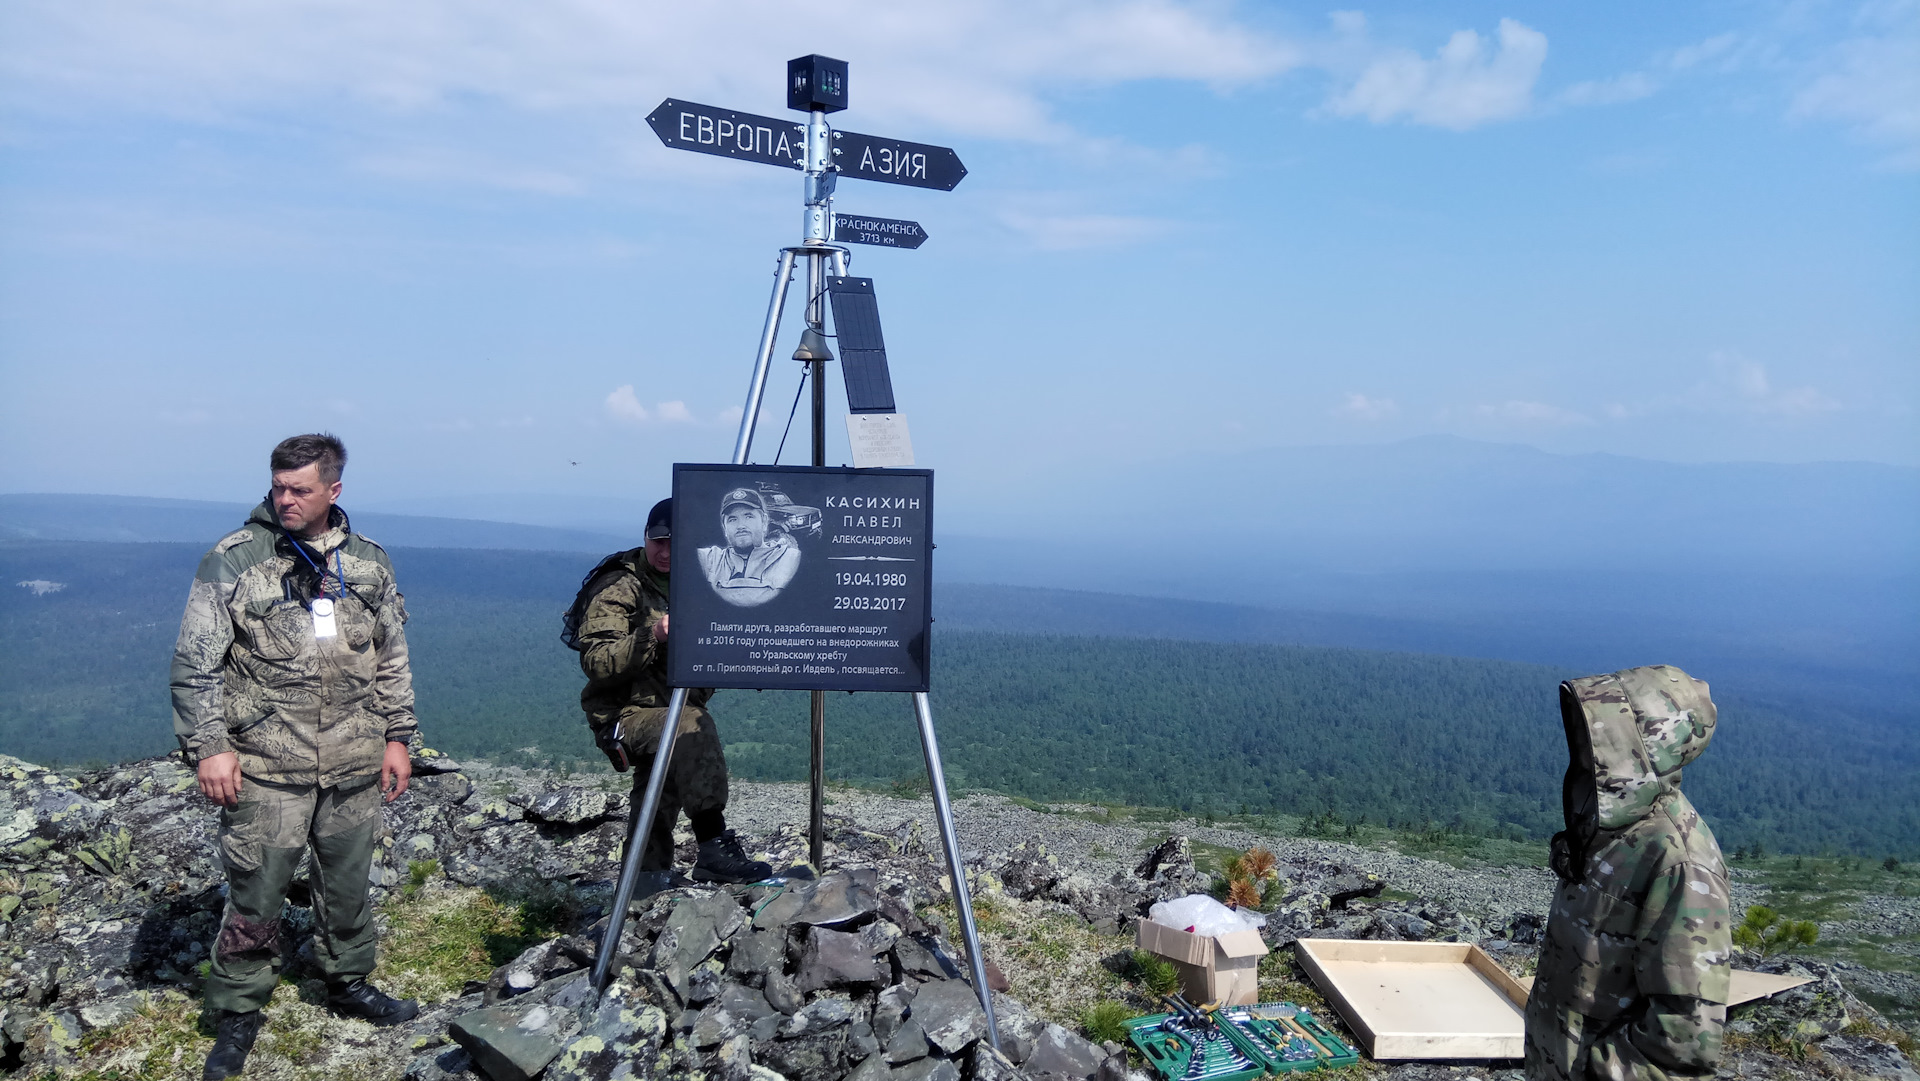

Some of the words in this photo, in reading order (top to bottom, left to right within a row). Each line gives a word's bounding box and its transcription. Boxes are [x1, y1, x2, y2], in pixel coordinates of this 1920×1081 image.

[680, 112, 792, 158] ЕВРОПА
[860, 146, 926, 179] АЗИЯ
[835, 218, 919, 236] КРАСНОКАМЕНСК
[859, 232, 880, 243] 3713
[883, 237, 895, 245] км
[826, 496, 920, 509] КАСИХИН
[843, 516, 902, 527] ПАВЕЛ
[832, 535, 912, 545] АЛЕКСАНДРОВИЧ
[836, 572, 907, 586] 19.04.1980
[833, 597, 906, 610] 29.03.2017
[710, 622, 743, 632] Памяти
[745, 624, 772, 633] друга,
[774, 623, 846, 634] разработавшего
[848, 626, 887, 635] маршрут
[713, 636, 734, 645] 2016
[736, 638, 756, 647] году
[758, 637, 814, 647] прошедшего
[829, 639, 899, 648] внедорожниках
[750, 651, 761, 659] по
[763, 650, 815, 661] Уральскому
[817, 651, 848, 661] хребту
[717, 663, 780, 674] Приполярный
[782, 665, 793, 674] до
[795, 665, 802, 673] г.
[842, 666, 906, 675] посвящается...
